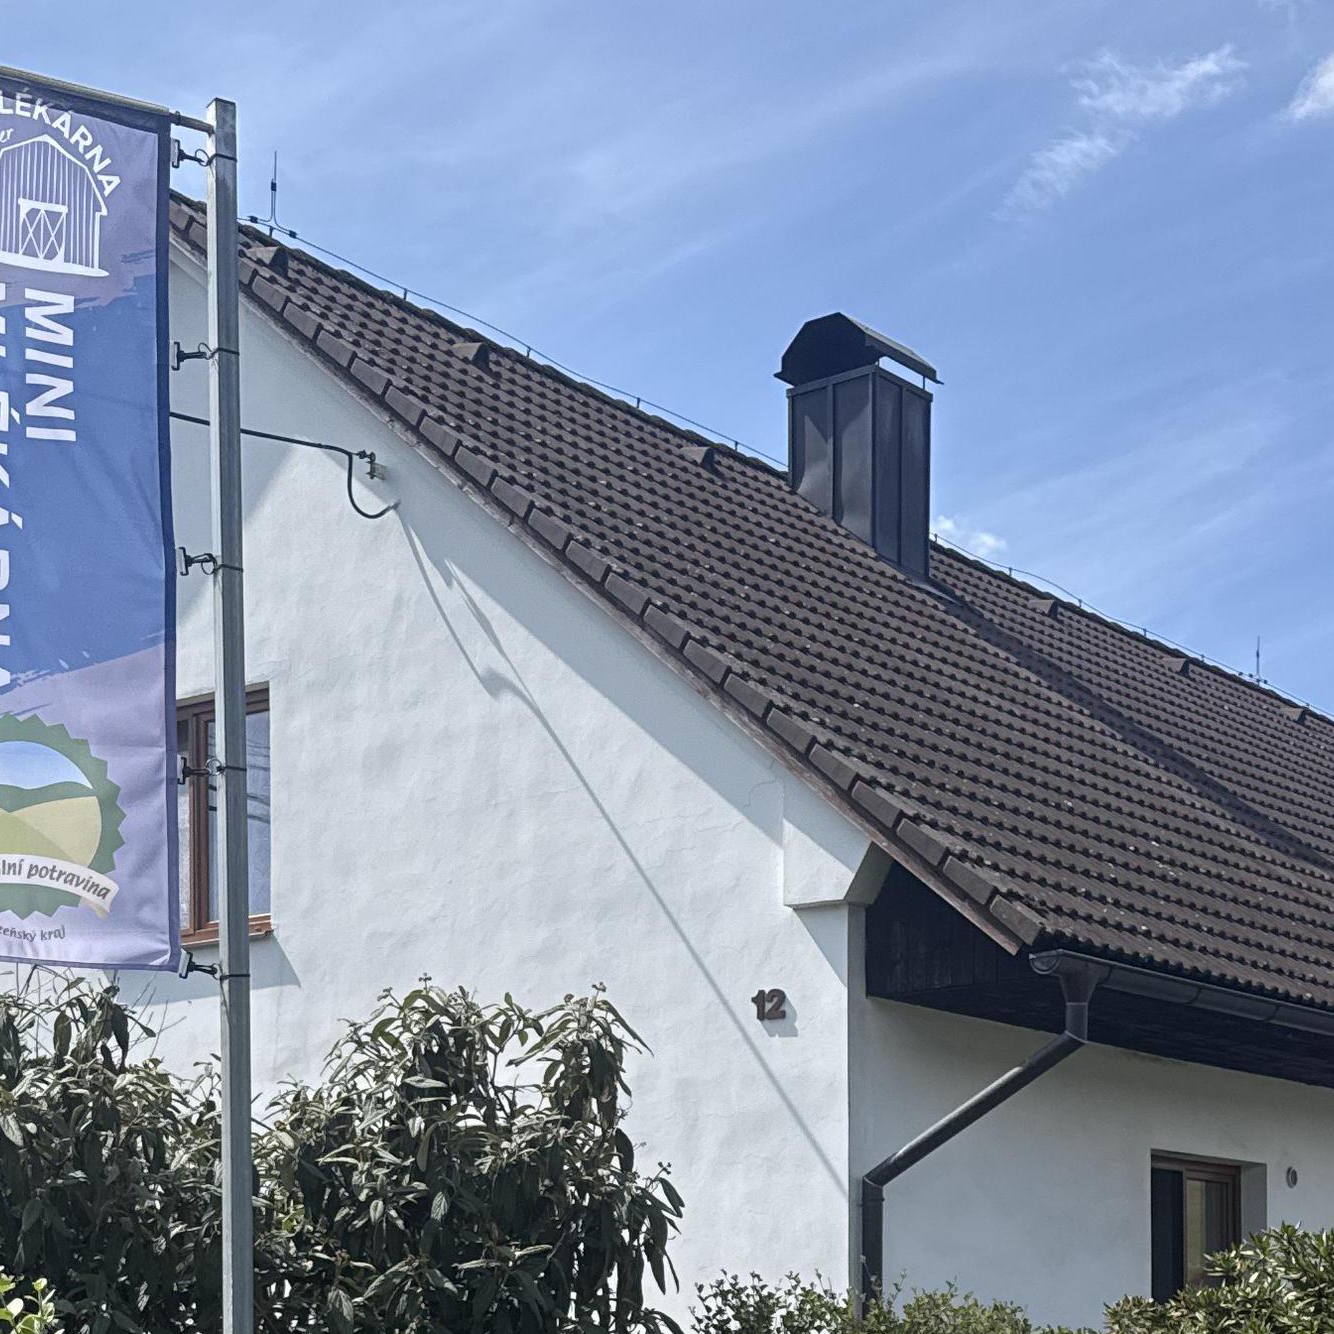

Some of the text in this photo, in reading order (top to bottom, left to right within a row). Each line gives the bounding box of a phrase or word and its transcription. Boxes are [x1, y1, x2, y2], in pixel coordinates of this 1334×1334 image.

[24, 287, 77, 442] MINI
[27, 862, 111, 900] potravina
[40, 924, 66, 941] kraj
[751, 989, 786, 1021] 12
